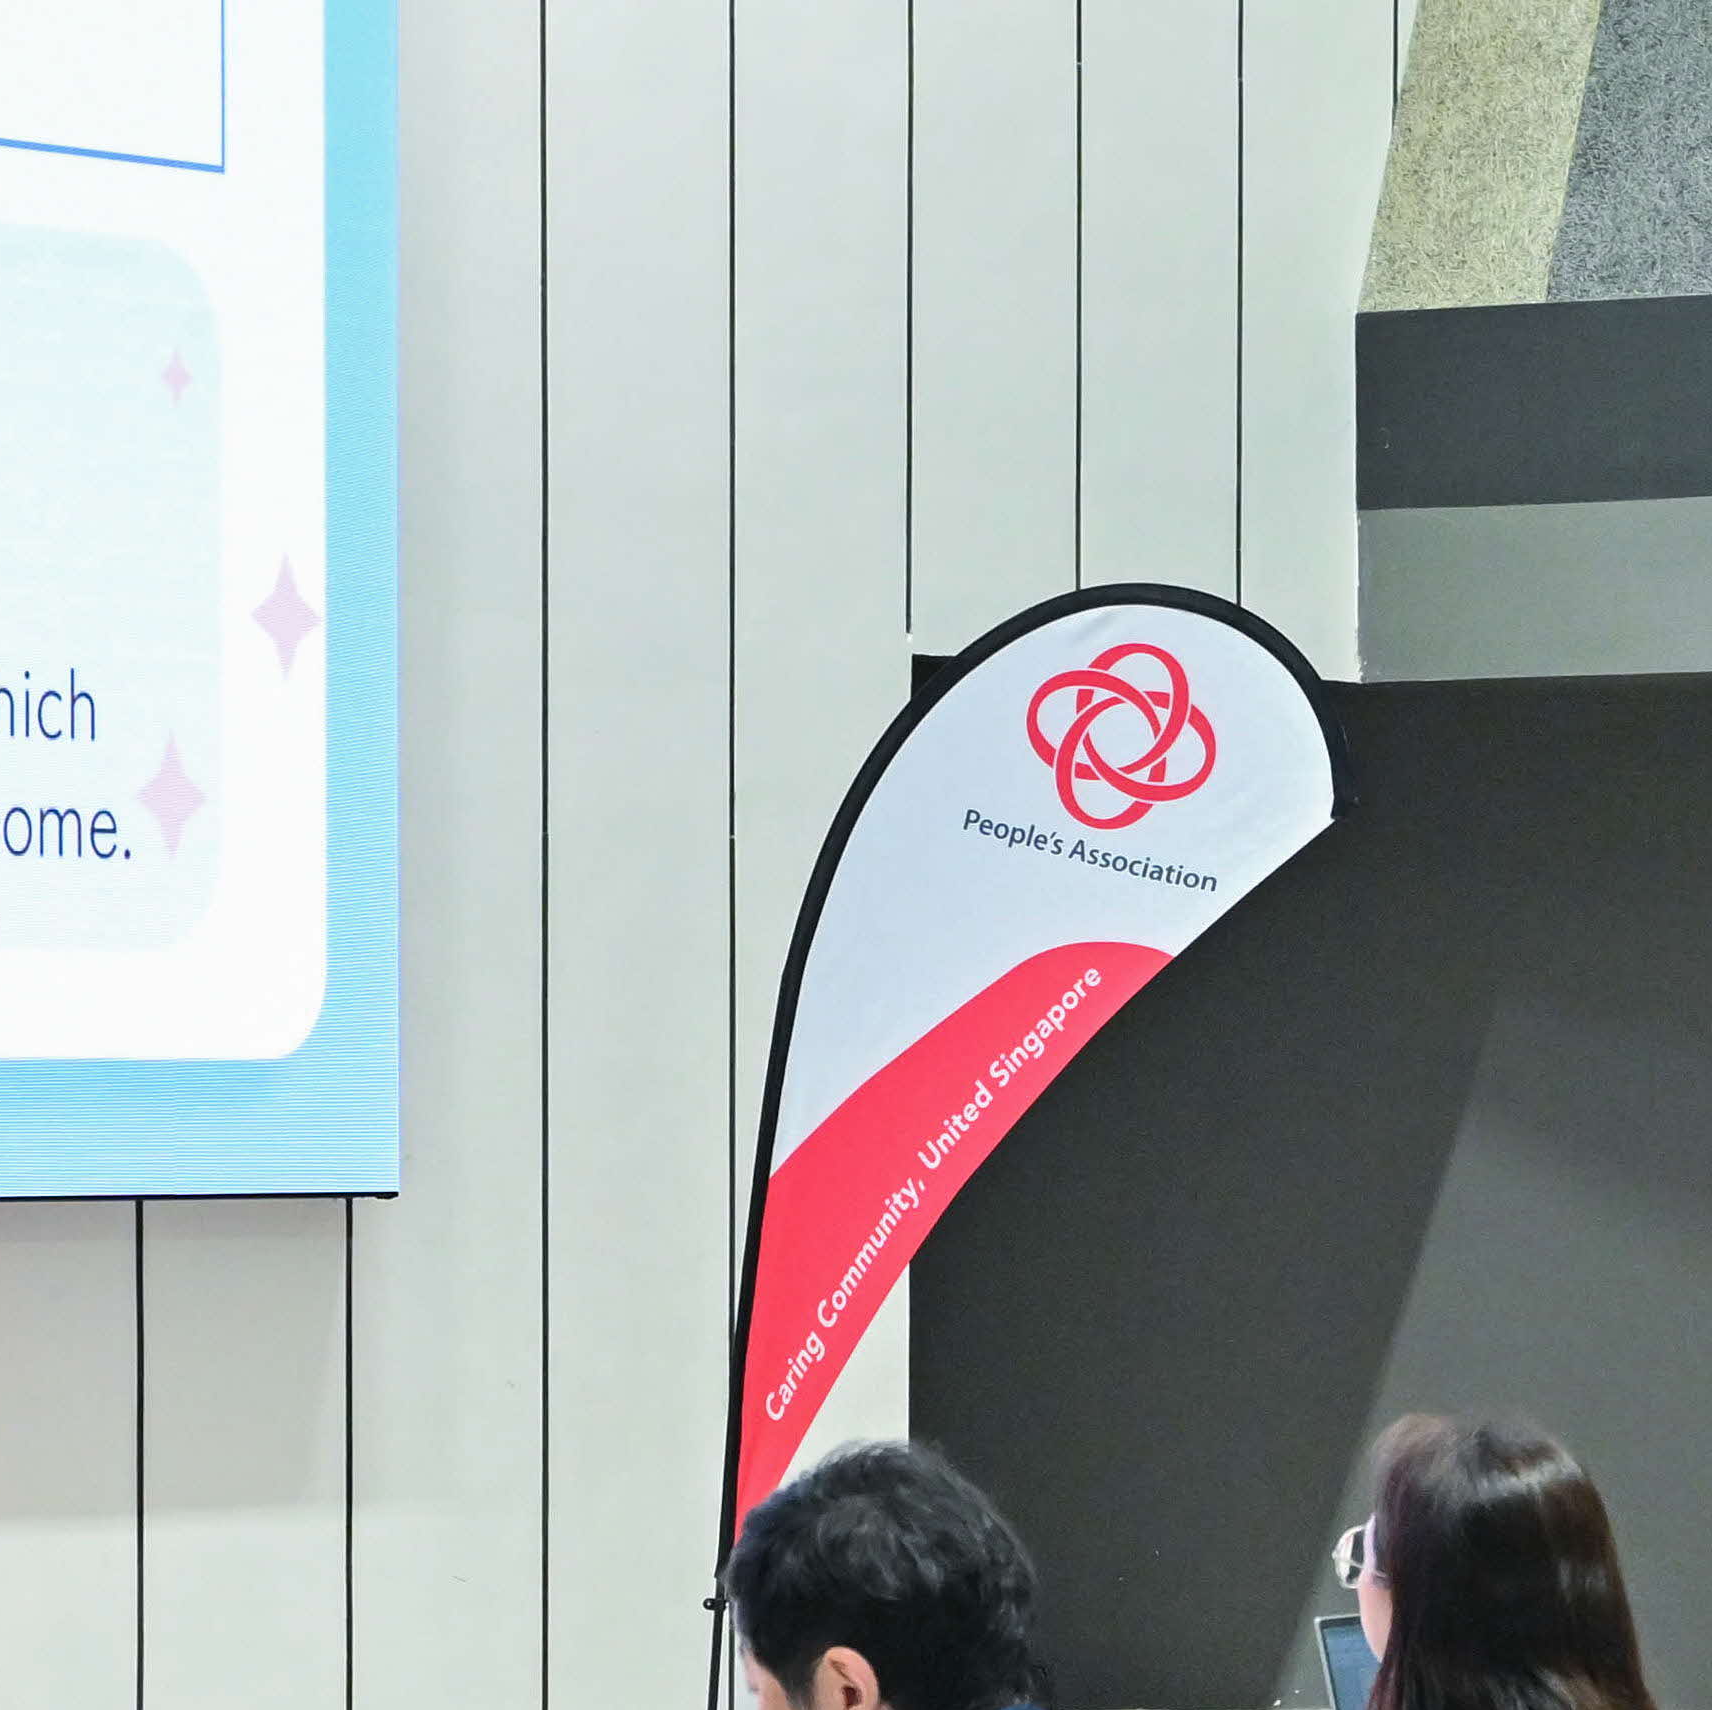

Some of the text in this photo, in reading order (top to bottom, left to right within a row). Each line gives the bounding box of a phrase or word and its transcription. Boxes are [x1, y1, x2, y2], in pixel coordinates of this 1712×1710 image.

[1067, 837, 1218, 893] Association
[764, 965, 1102, 1423] Caring Community, United Singapore
